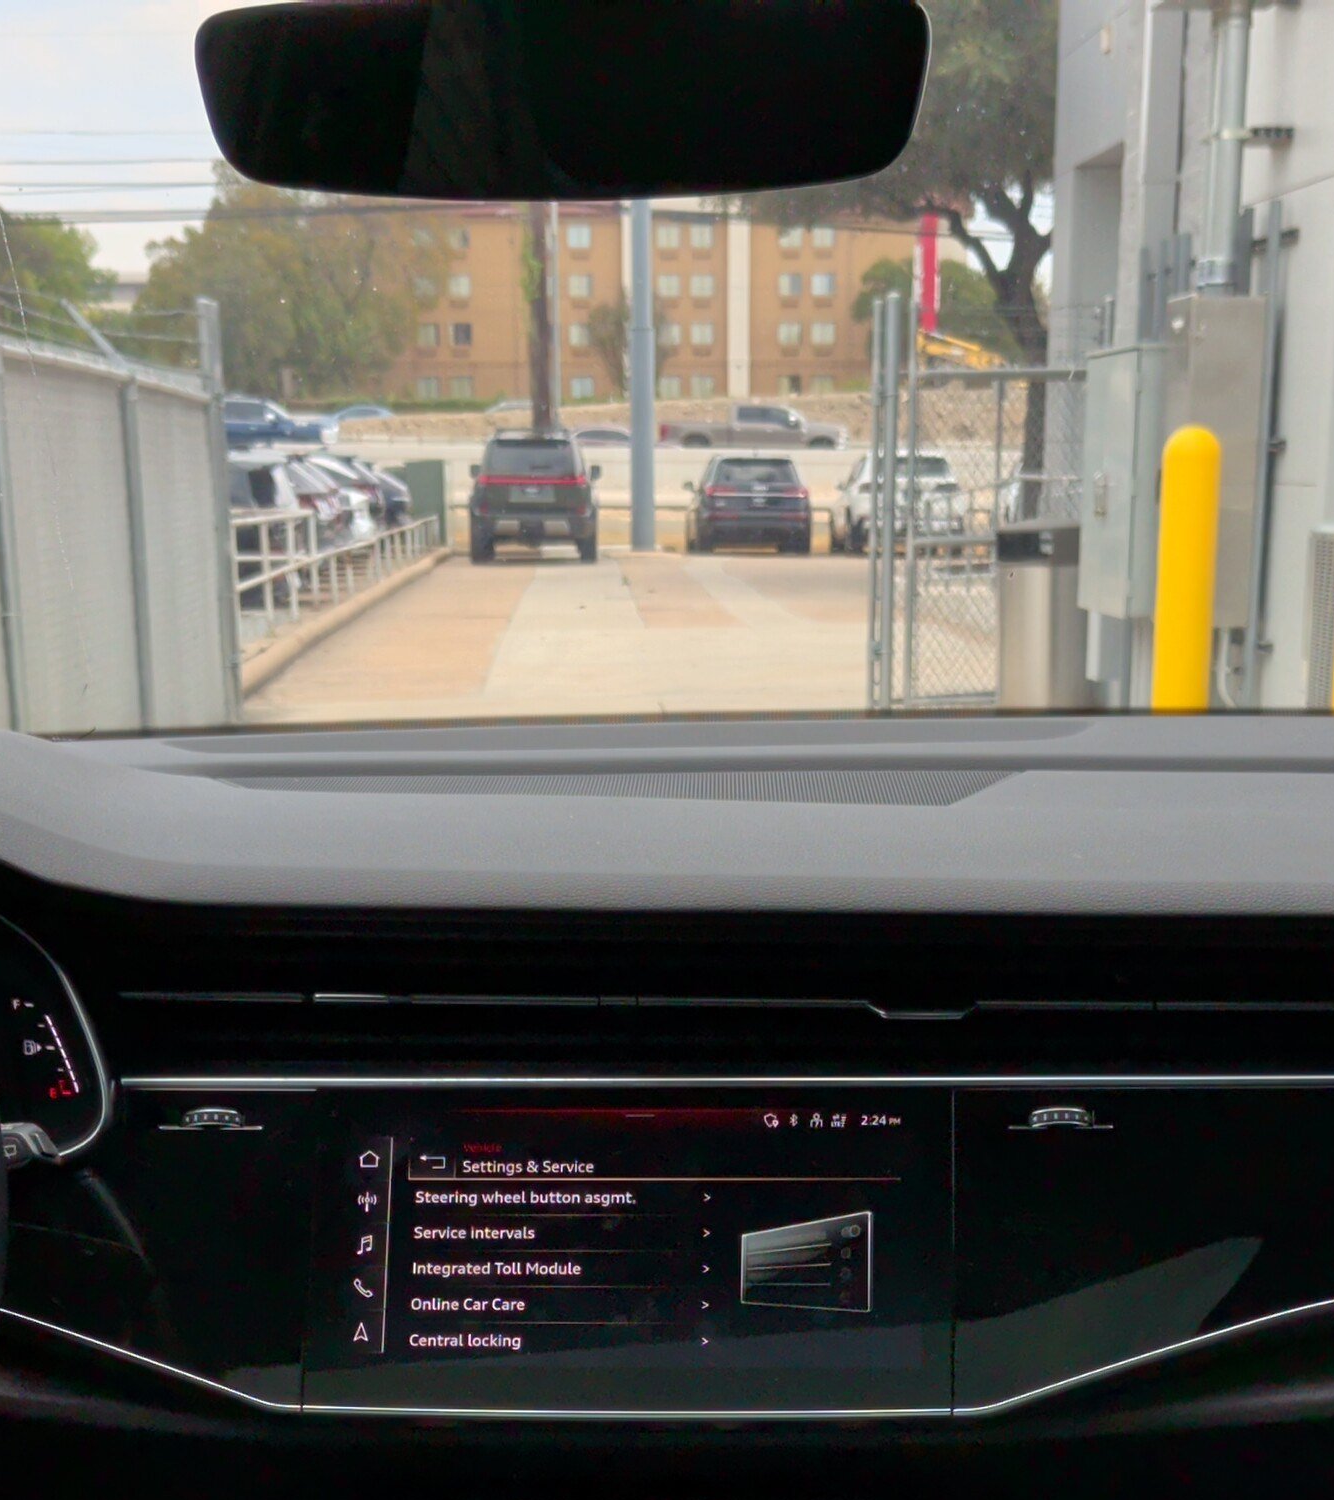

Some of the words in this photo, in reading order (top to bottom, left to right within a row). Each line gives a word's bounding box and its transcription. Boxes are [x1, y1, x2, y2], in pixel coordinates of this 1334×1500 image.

[861, 1114, 887, 1126] 2:24
[463, 1160, 522, 1175] Settings
[526, 1161, 539, 1173] &
[542, 1160, 595, 1173] Service
[415, 1190, 478, 1207] Steering
[482, 1190, 526, 1204] wheel
[530, 1190, 581, 1204] button
[584, 1192, 636, 1207] asgmt.
[413, 1226, 467, 1239] Service
[470, 1226, 535, 1240] intervals
[412, 1261, 491, 1278] Integrated
[495, 1261, 522, 1275] Toll
[525, 1261, 582, 1275] Module
[411, 1297, 459, 1311] Online
[463, 1298, 488, 1311] Car
[492, 1298, 525, 1311] Care
[409, 1333, 463, 1347] Central
[467, 1333, 522, 1350] locking
